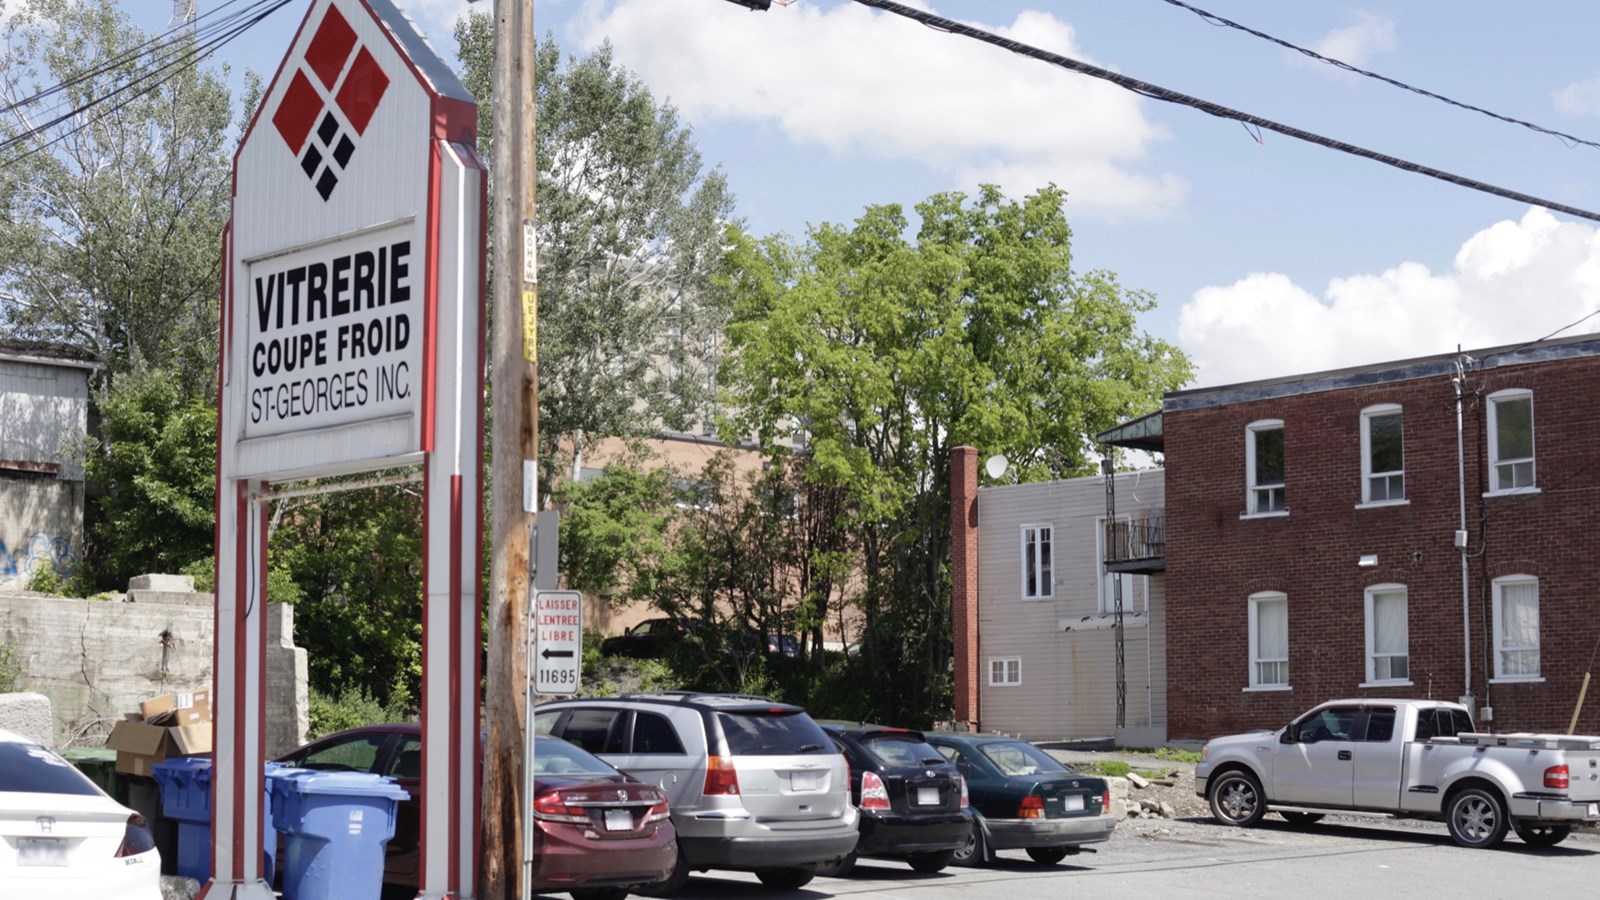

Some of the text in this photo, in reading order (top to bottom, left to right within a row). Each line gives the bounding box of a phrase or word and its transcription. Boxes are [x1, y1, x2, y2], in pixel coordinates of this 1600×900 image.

[255, 240, 411, 333] VITRERIE
[252, 313, 410, 378] COUPE FROID
[251, 361, 411, 424] ST-GEORGES INC.
[538, 599, 578, 611] LAISSER
[541, 630, 574, 641] LIBRE
[540, 669, 575, 684] 11695
